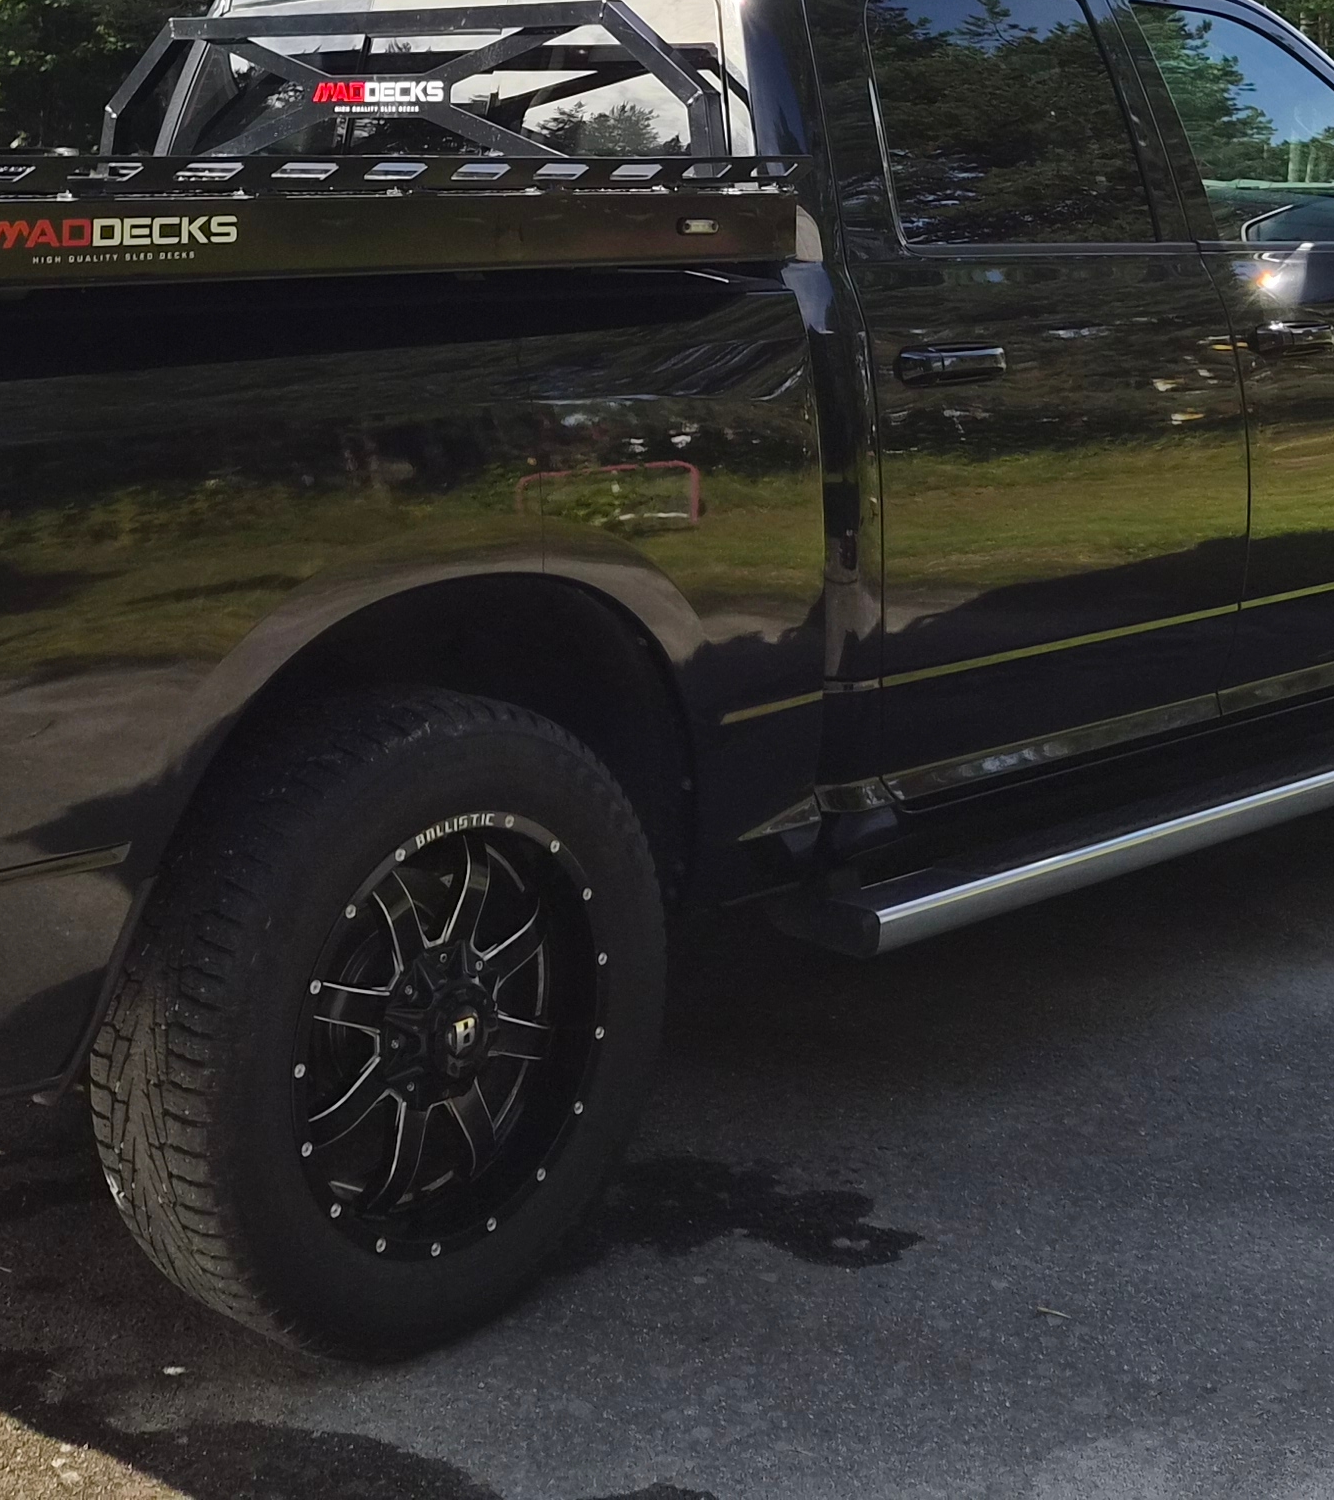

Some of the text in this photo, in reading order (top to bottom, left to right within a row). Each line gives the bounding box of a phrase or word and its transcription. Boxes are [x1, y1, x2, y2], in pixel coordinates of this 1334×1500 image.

[313, 81, 444, 102] MADDECKS
[32, 255, 62, 264] HIGH
[68, 253, 118, 263] QUALITY
[158, 250, 196, 260] DECKS
[415, 813, 496, 850] BALLISTIC
